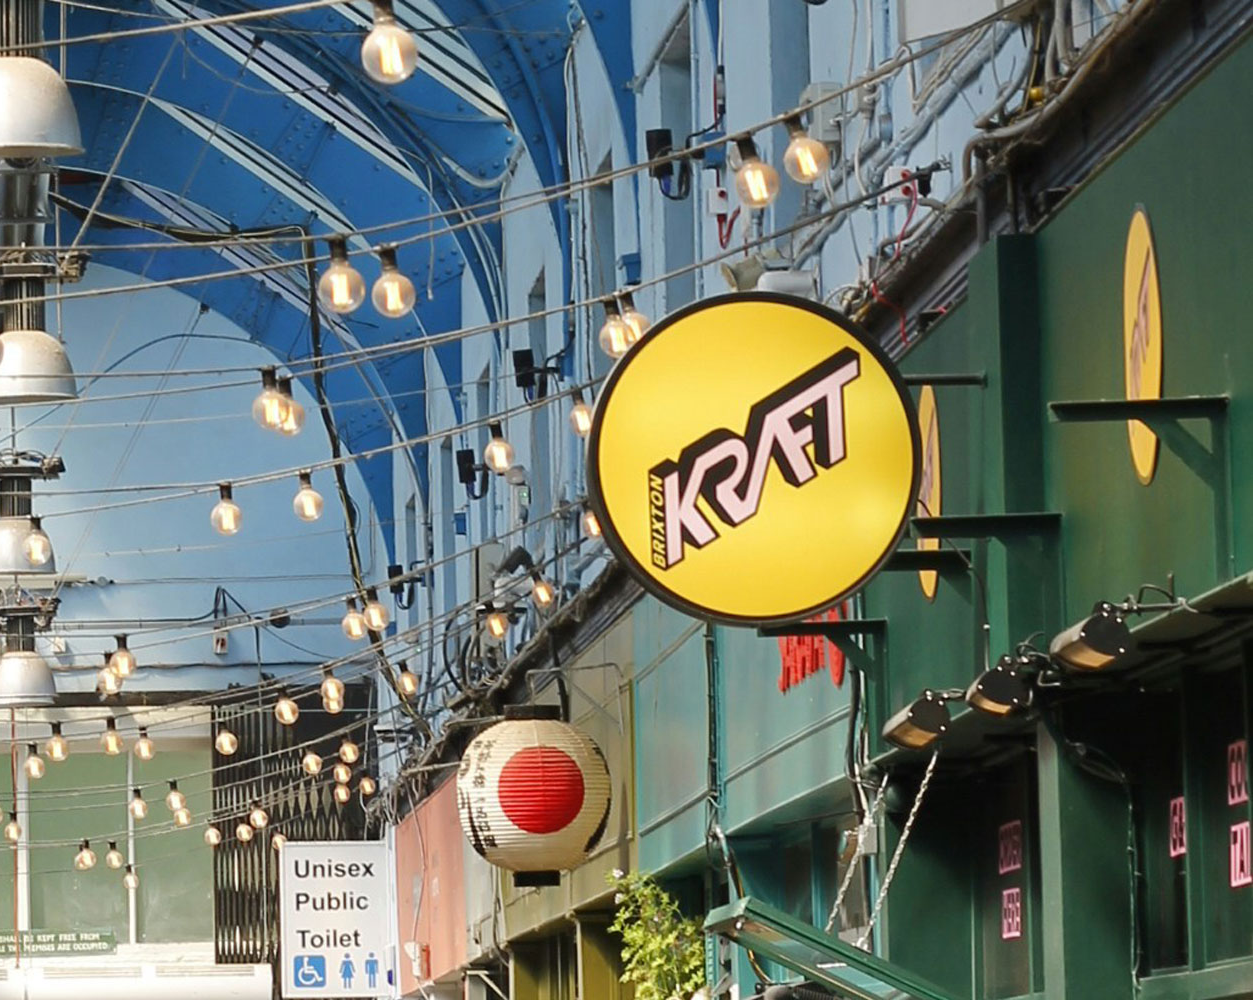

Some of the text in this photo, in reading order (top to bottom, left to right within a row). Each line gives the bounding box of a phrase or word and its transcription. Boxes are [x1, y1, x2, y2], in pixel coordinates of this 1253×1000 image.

[658, 346, 860, 568] KRAFT
[649, 475, 666, 568] BRIXTON
[294, 859, 375, 878] Unisex
[295, 892, 369, 911] Public
[37, 934, 55, 942] KEPT
[59, 933, 76, 941] FREE
[80, 933, 99, 941] FROM
[57, 942, 70, 950] ARE
[73, 941, 108, 950] OCCUPIED
[296, 929, 361, 948] Toilet
